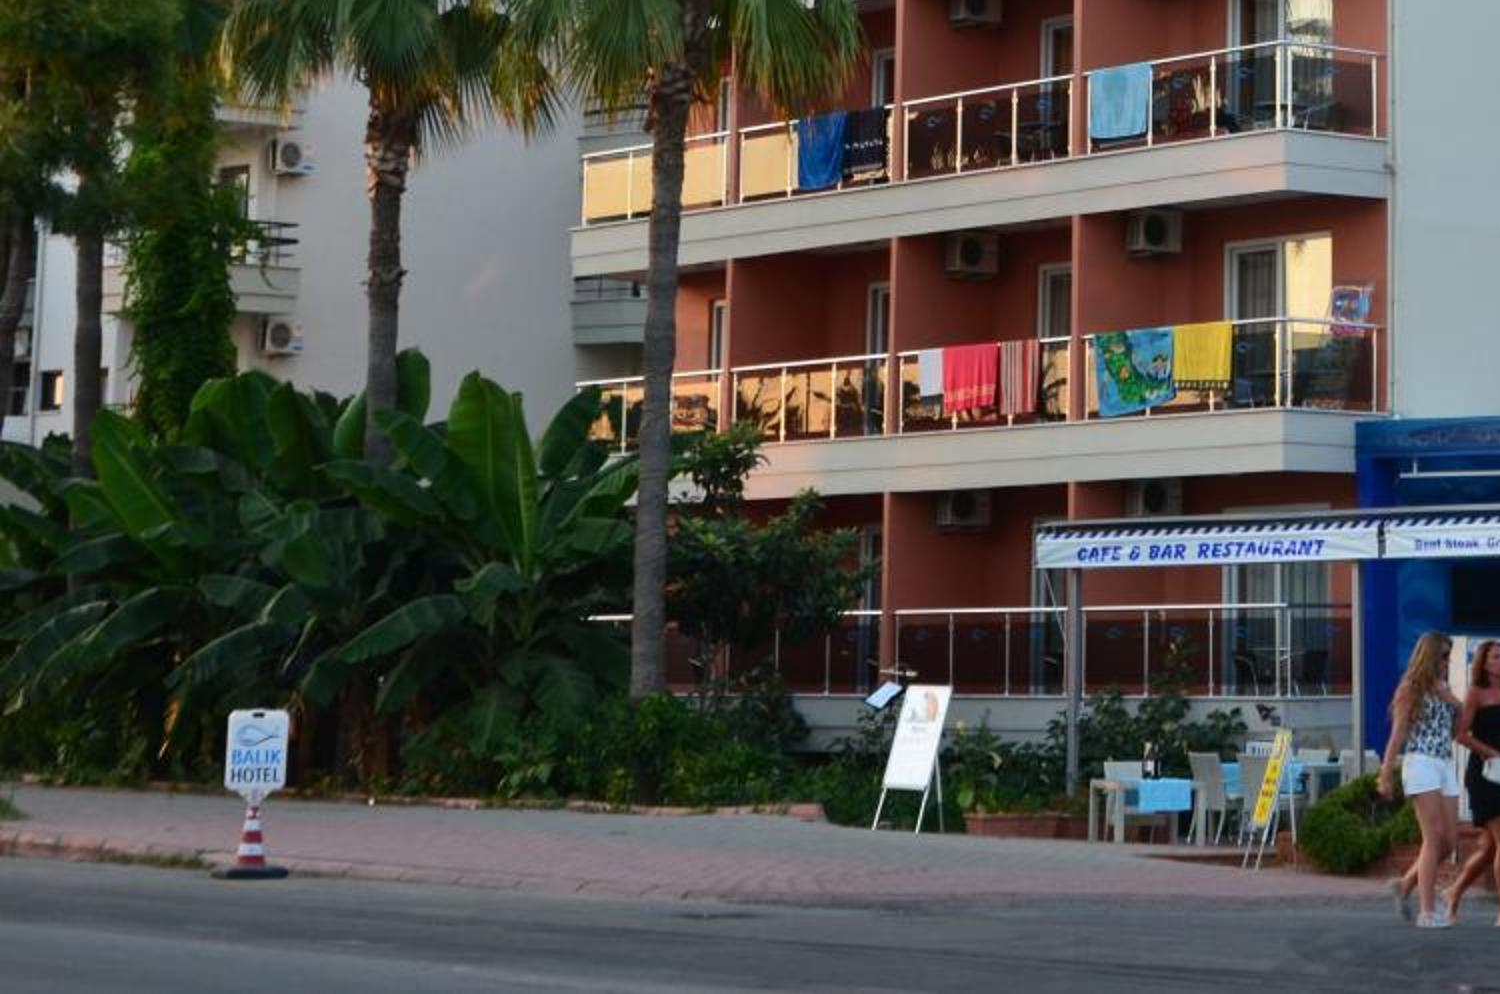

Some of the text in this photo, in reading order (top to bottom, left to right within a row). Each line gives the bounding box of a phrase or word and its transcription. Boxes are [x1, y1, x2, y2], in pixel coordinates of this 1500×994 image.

[1076, 539, 1325, 562] CAFE & BAR RESTAURANT
[231, 749, 281, 766] BALIK
[230, 767, 280, 783] HOTEL
